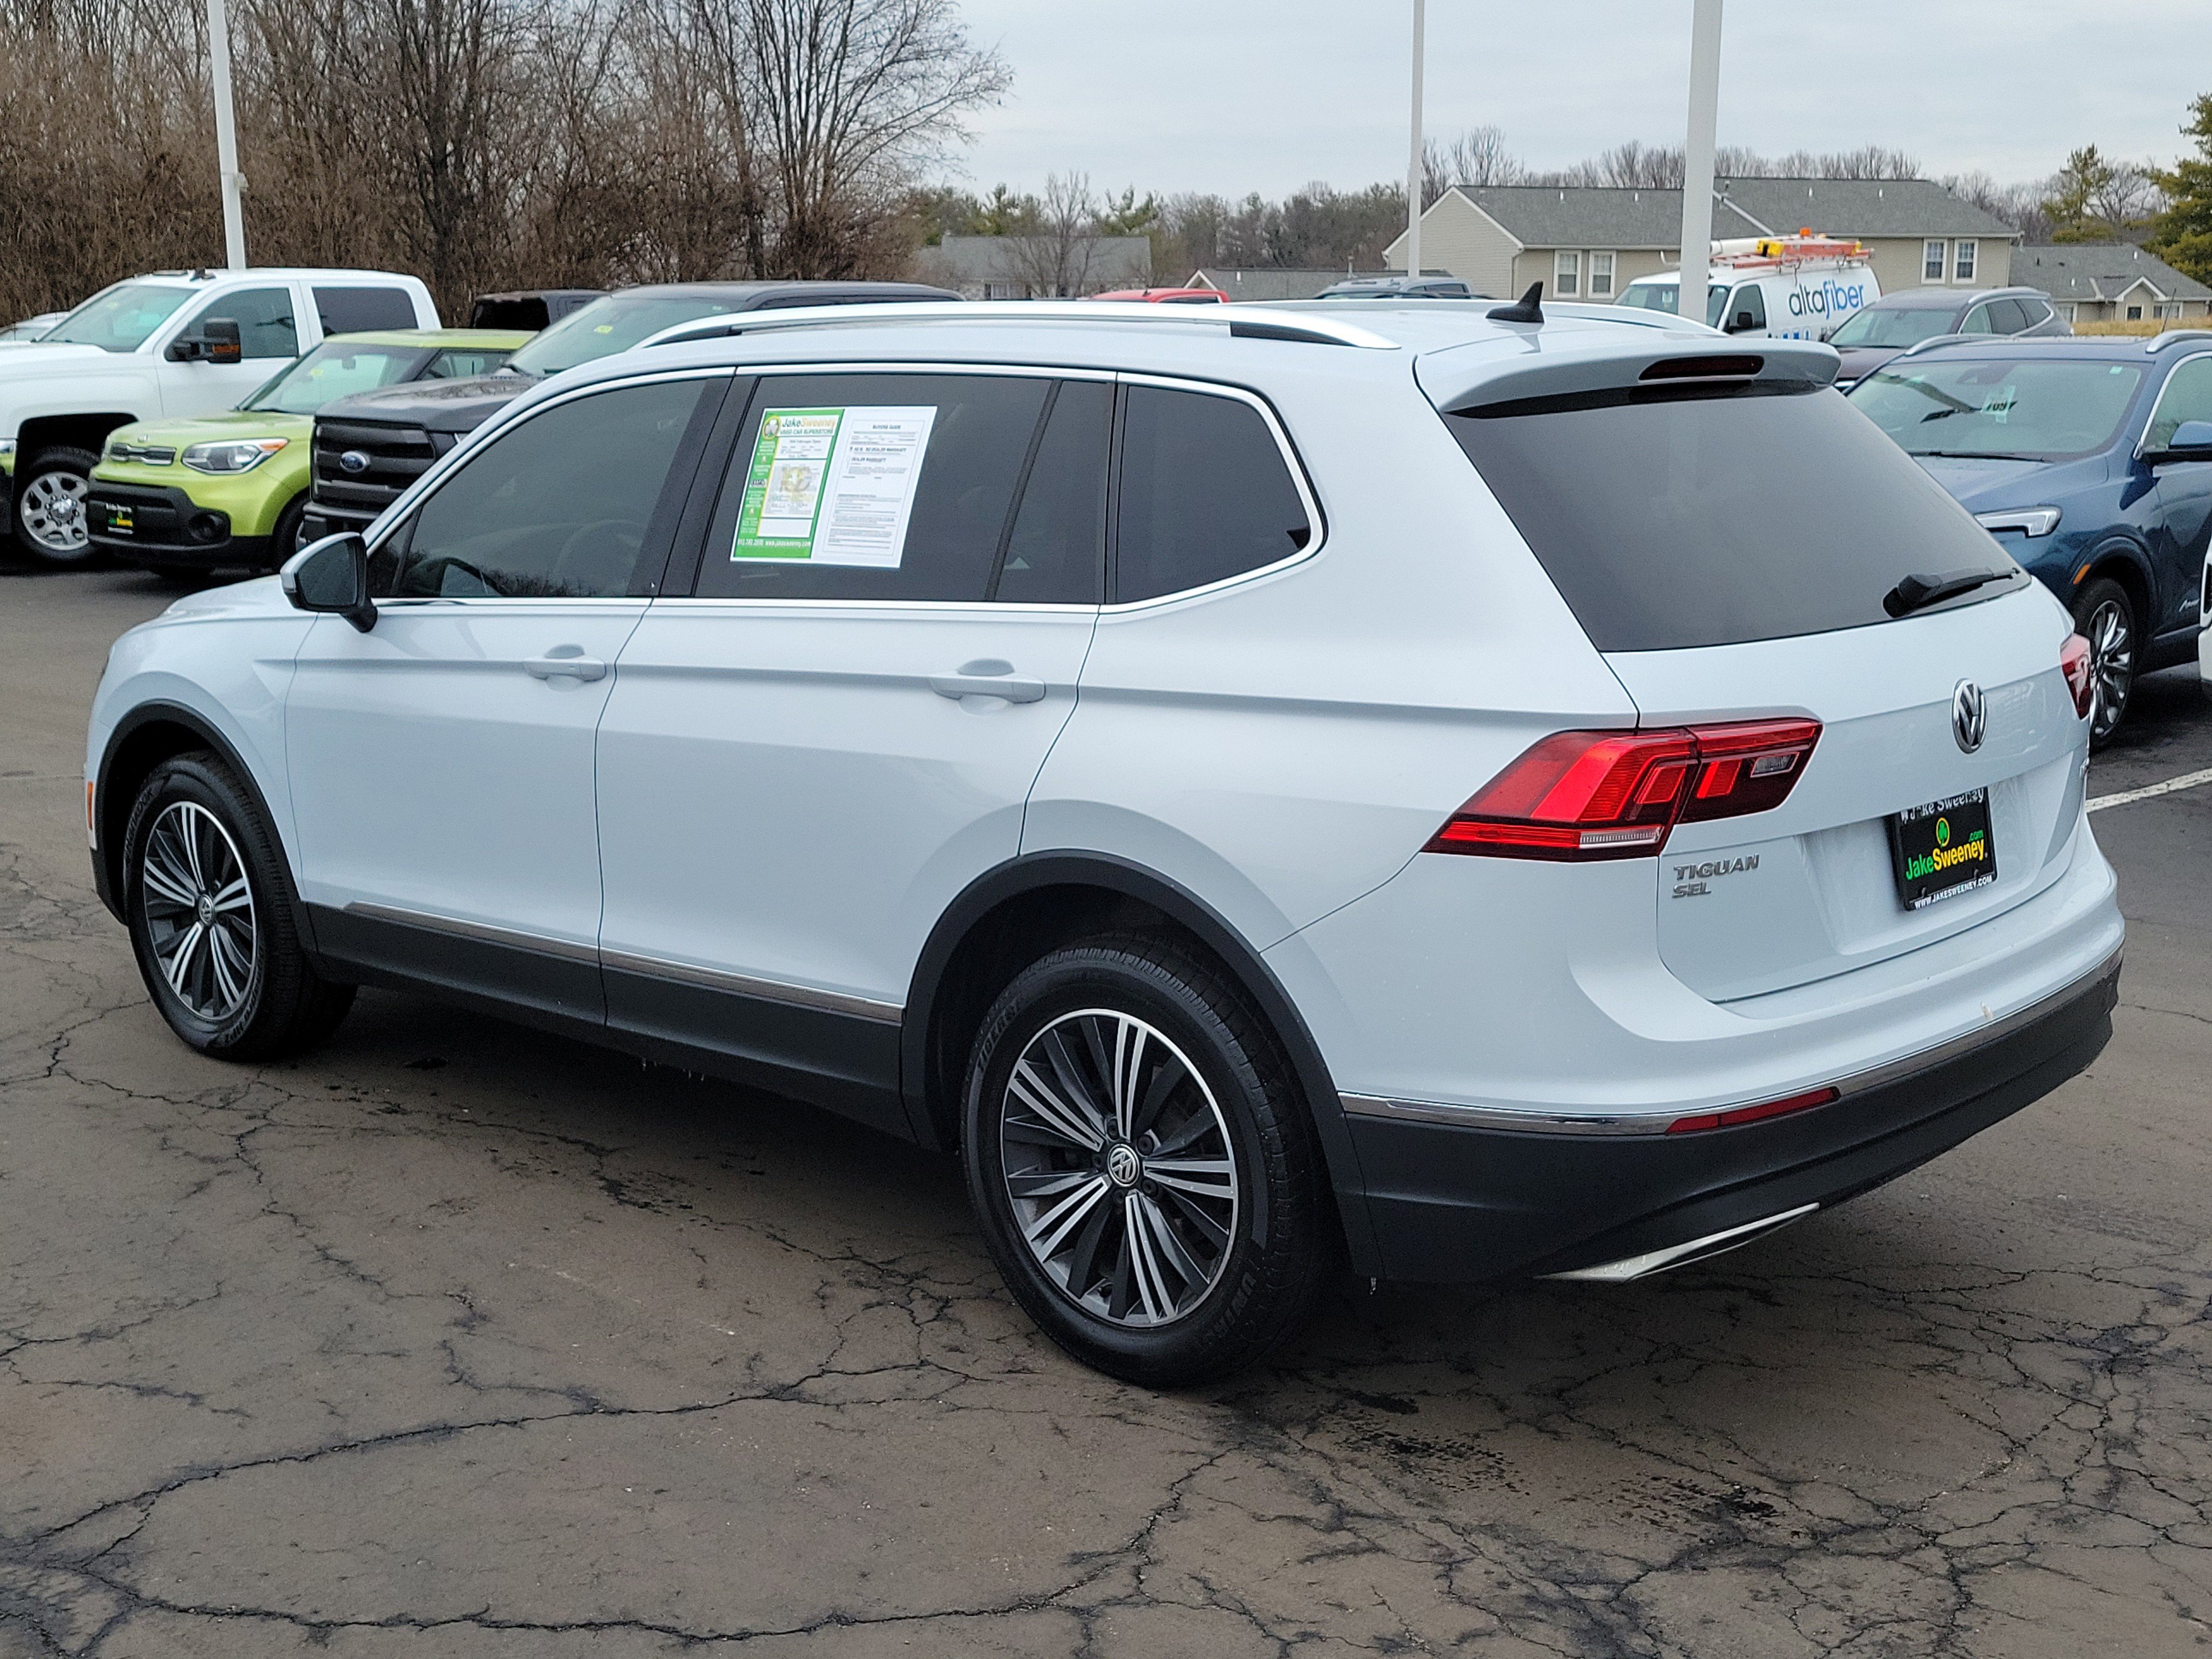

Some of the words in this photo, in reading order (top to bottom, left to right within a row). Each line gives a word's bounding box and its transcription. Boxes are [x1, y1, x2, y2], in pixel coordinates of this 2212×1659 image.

[1789, 280, 1864, 319] altafiber
[1968, 830, 1984, 842] .com
[1673, 854, 1759, 881] TIGUAN
[1906, 839, 1984, 881] JakeSweeney
[1672, 882, 1712, 898] SEL
[1915, 874, 1993, 910] WWW.JAKESWEENEY.COM
